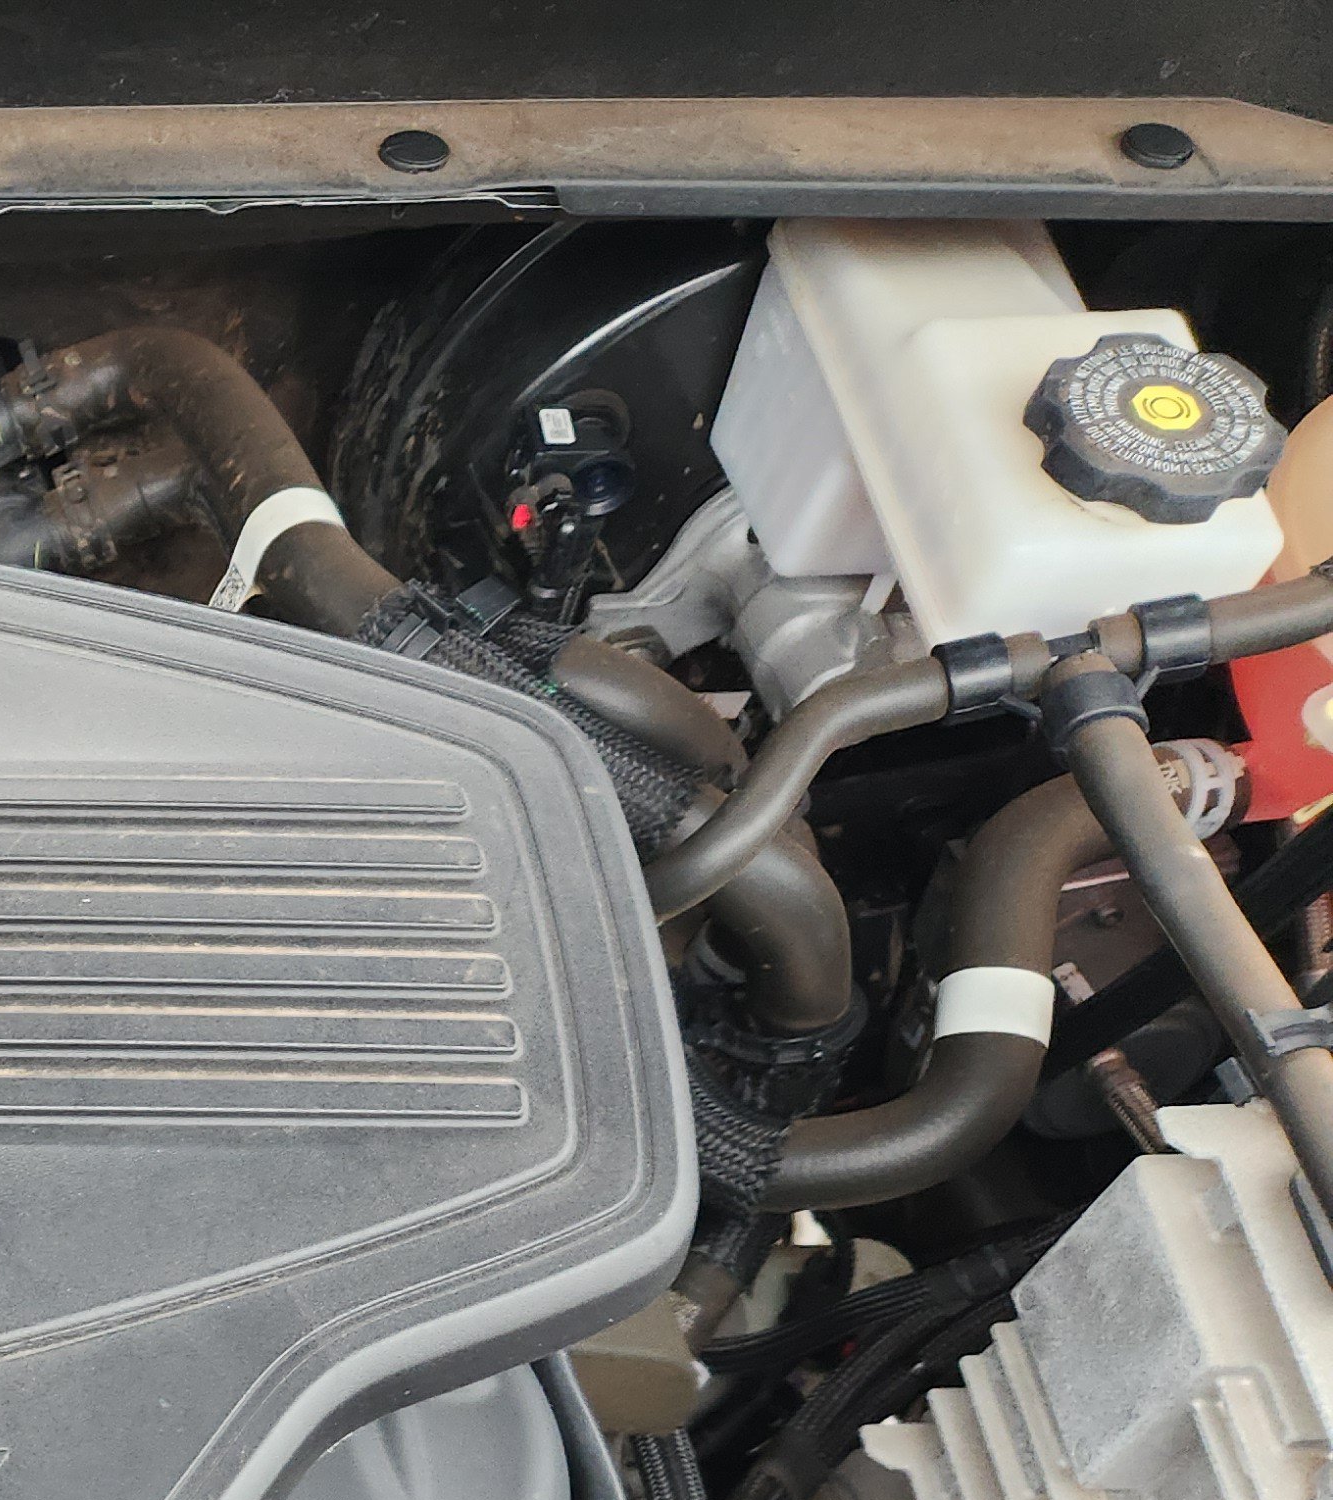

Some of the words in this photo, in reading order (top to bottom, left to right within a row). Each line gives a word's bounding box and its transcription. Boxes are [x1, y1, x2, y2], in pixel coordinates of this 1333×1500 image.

[1132, 343, 1190, 361] BOUCHON
[1139, 355, 1185, 370] LIQUIDE
[1158, 366, 1197, 385] BIDON
[1099, 421, 1123, 439] CAP
[1115, 433, 1163, 459] BEFORE
[1113, 418, 1168, 449] WARNING
[1085, 425, 1113, 448] DOT4
[1109, 443, 1146, 466] FLUID
[1145, 457, 1181, 474] FROM
[1181, 463, 1192, 475] A
